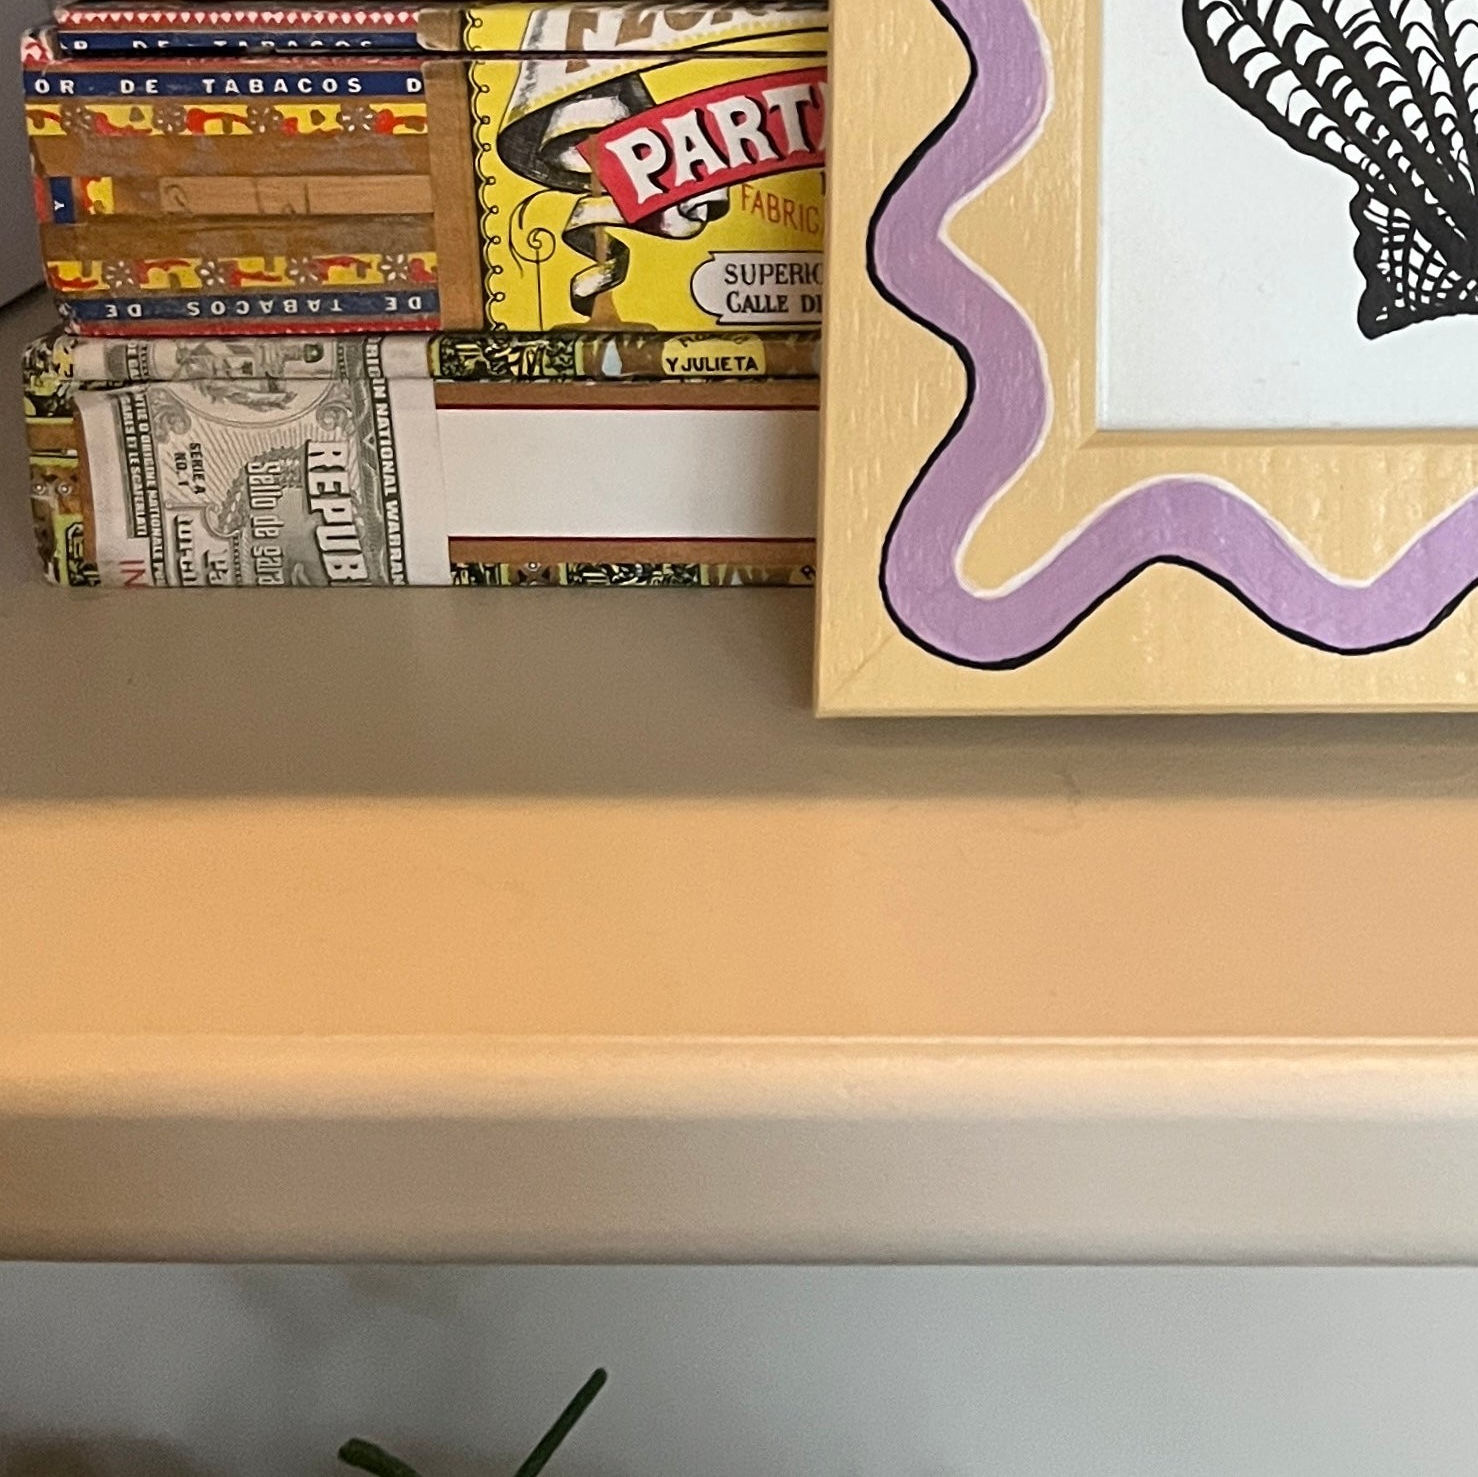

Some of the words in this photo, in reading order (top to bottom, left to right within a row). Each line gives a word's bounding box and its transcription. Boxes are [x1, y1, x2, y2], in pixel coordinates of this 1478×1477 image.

[120, 79, 159, 95] DE
[202, 77, 362, 95] TABACOS
[605, 82, 826, 205] PART
[106, 302, 143, 319] DE
[187, 298, 343, 318] TABACOS
[384, 296, 423, 312] DE
[801, 295, 823, 314] D
[682, 356, 759, 372] JULIETA
[375, 402, 397, 497] NATIONAL
[189, 442, 205, 481] SERIE
[194, 485, 206, 495] A
[247, 461, 283, 509] Sello
[308, 441, 371, 586] REPUB
[252, 515, 285, 539] de
